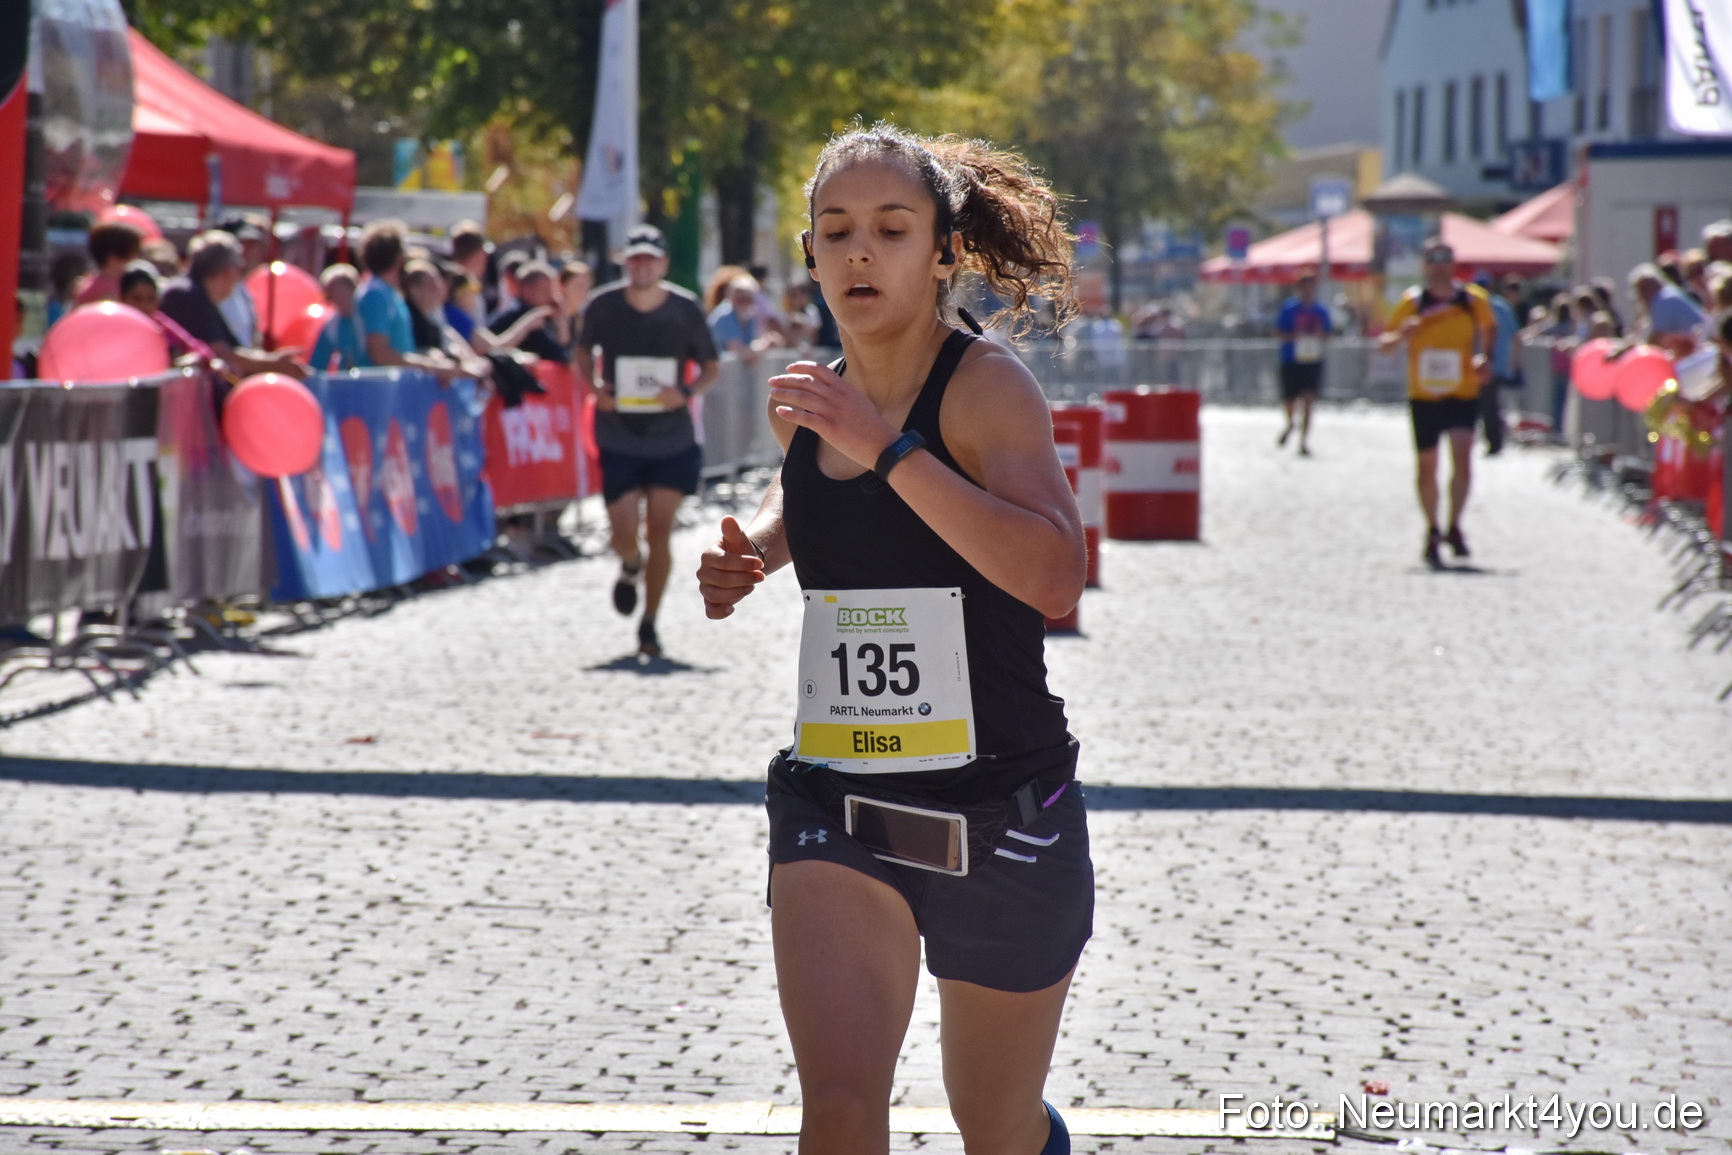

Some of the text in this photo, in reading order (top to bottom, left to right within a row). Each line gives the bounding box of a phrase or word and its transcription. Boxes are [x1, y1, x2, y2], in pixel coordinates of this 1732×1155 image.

[837, 607, 908, 626] BOCK
[836, 626, 855, 634] inspired
[831, 642, 921, 697] 135
[830, 705, 859, 716] PARTL
[861, 706, 914, 717] Neumarkt
[853, 731, 902, 753] Elisa
